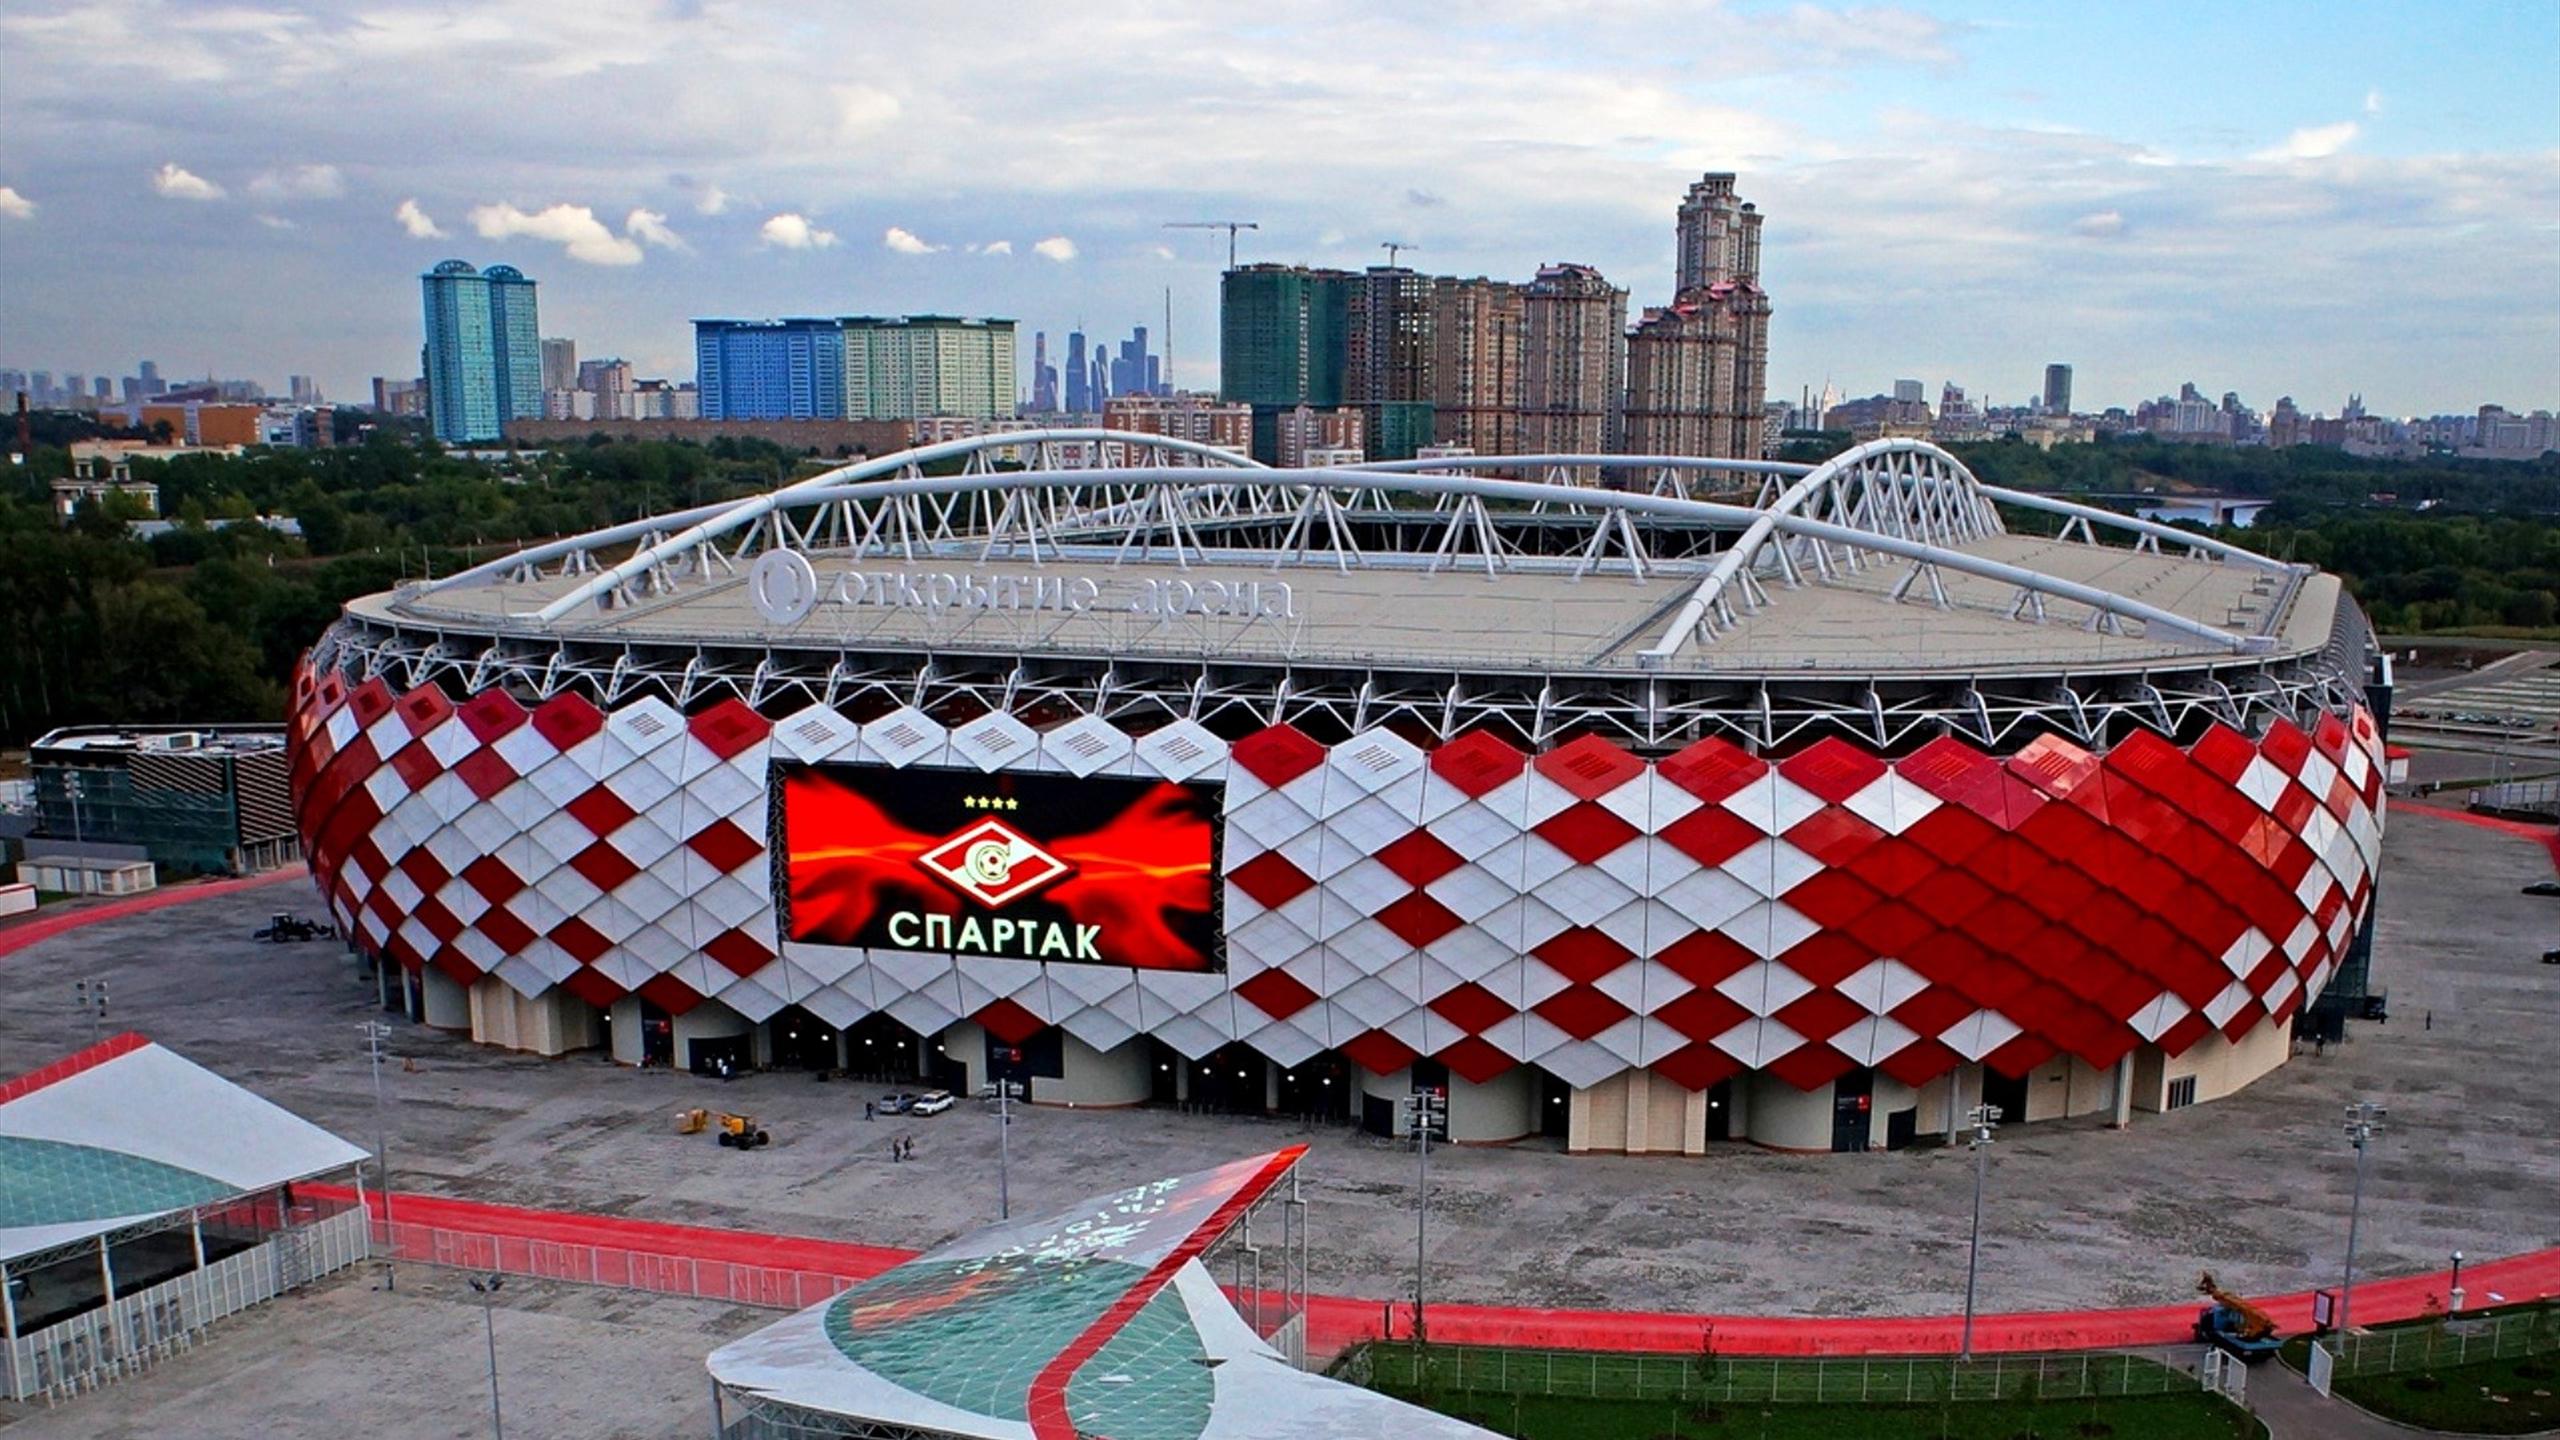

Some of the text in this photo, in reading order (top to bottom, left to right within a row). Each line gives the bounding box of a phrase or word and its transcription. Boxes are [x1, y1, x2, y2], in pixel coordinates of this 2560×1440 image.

[837, 571, 1294, 632] открытие арена
[888, 911, 1101, 960] СПАРТАК
